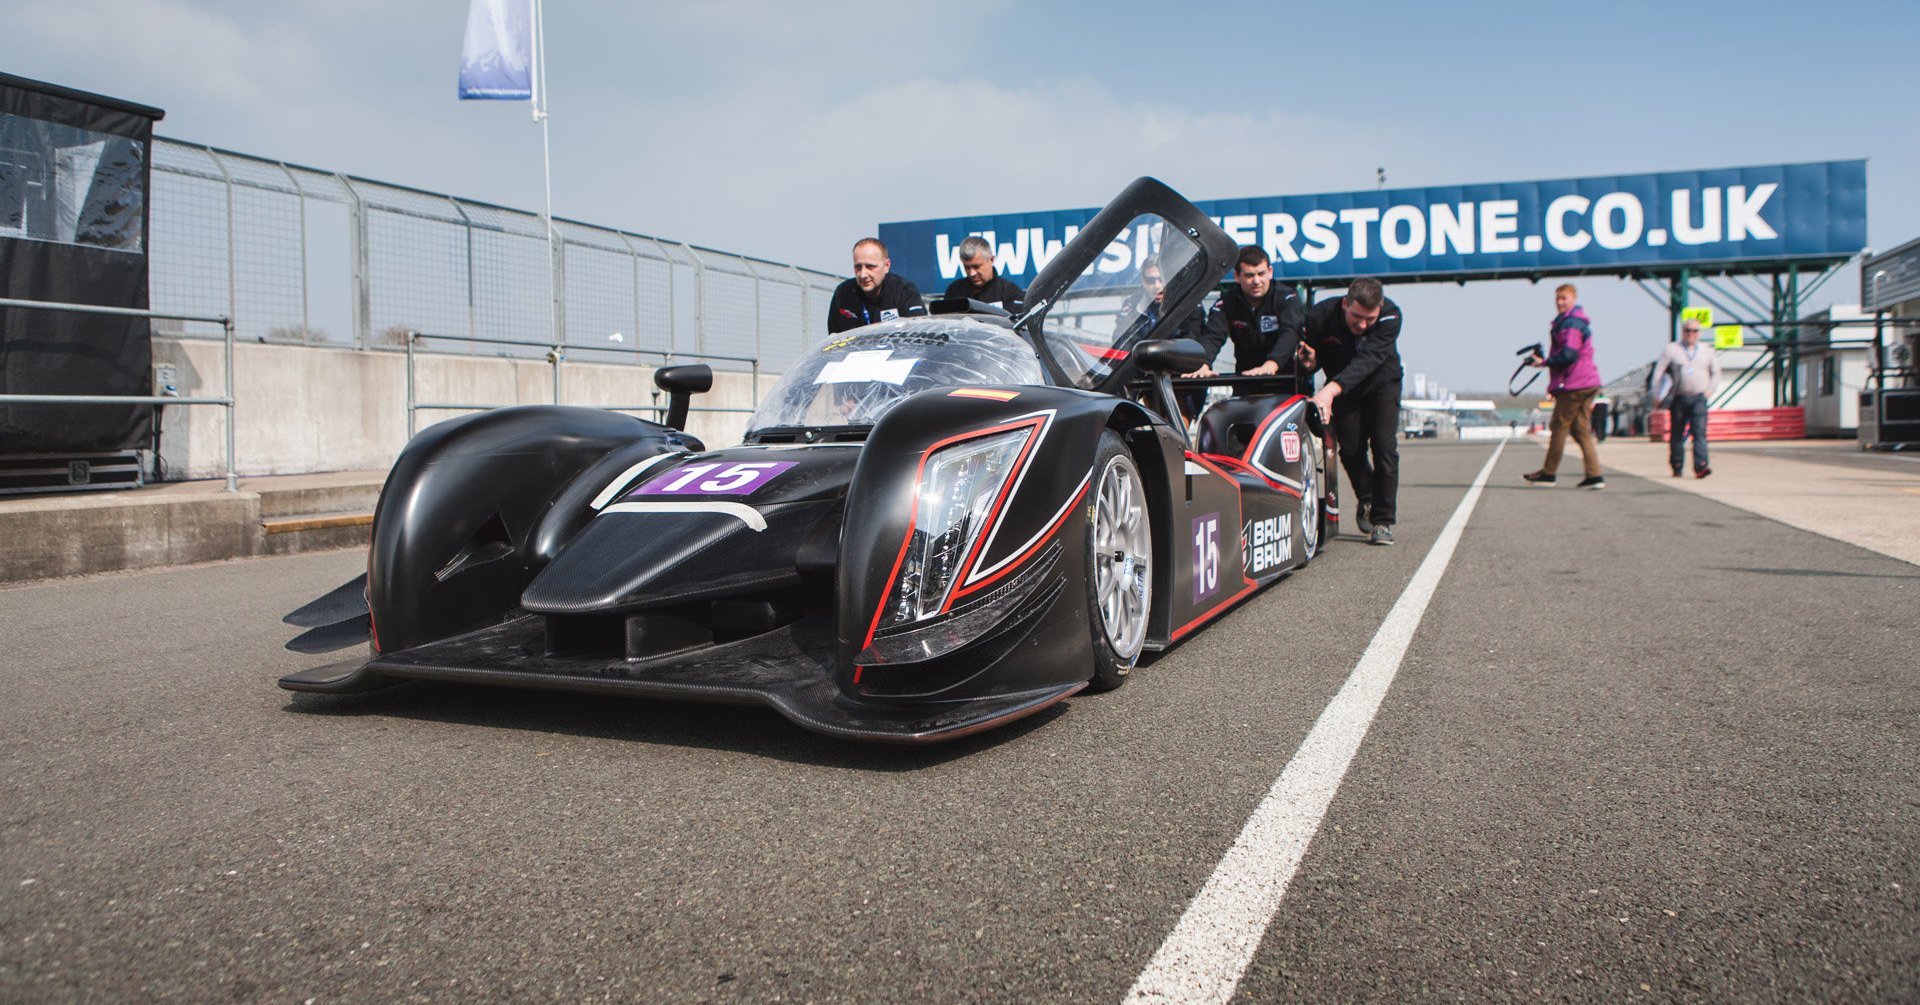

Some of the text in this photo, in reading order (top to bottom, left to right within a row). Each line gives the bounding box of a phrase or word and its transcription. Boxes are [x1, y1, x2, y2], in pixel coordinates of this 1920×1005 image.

[661, 463, 778, 492] 15
[1253, 513, 1292, 547] BRUM
[1195, 519, 1218, 595] 15
[1253, 536, 1292, 573] BRUM
